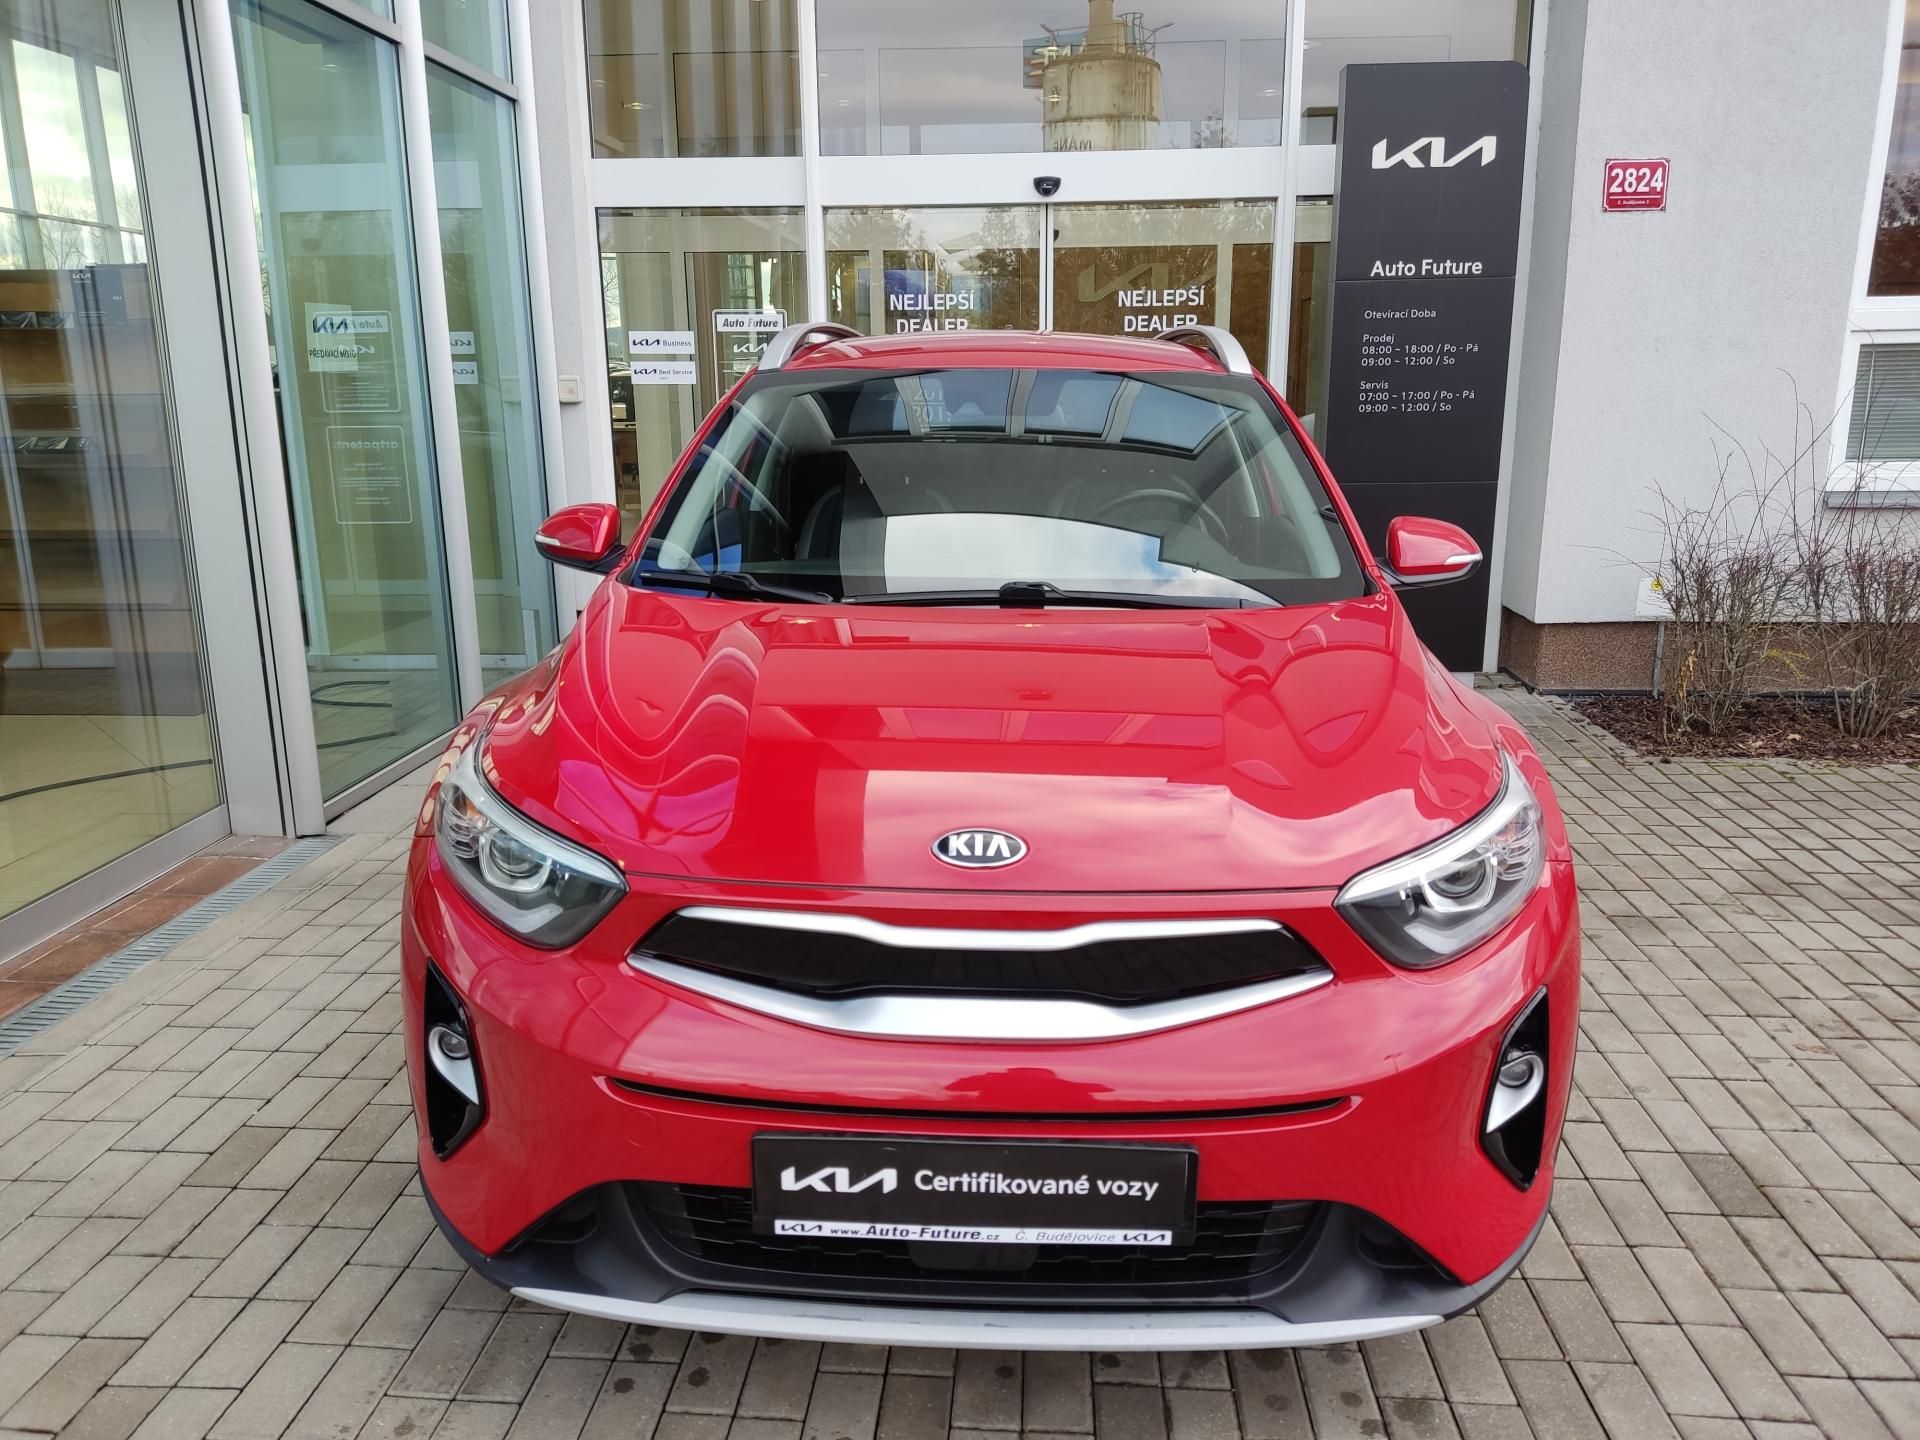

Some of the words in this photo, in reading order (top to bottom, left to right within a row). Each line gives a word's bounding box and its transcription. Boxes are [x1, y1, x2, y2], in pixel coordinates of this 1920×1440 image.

[1372, 135, 1497, 169] KIA
[1609, 167, 1664, 193] 2824
[1370, 260, 1416, 277] Auto
[1421, 259, 1483, 276] Future
[890, 290, 974, 311] NEJLEPŠÍ
[1118, 285, 1205, 307] NEJLEPŠÍ
[1364, 309, 1409, 319] Otevírací
[1411, 309, 1437, 318] Doba
[722, 318, 745, 328] Auto
[747, 318, 779, 328] Future
[632, 338, 660, 347] KIA
[663, 339, 692, 347] Business
[1363, 333, 1395, 344] Prodej
[1362, 345, 1392, 355] 08:00
[1404, 344, 1434, 354] 18:00
[1444, 344, 1457, 353] Po
[1466, 343, 1479, 352] Pá
[1361, 357, 1391, 367] 09:00
[1404, 356, 1433, 366] 12:00
[1442, 355, 1455, 365] So
[1360, 380, 1389, 390] Servis
[1359, 392, 1389, 401] 07:00
[1401, 391, 1430, 400] 17:00
[1440, 390, 1453, 400] Po
[1462, 390, 1475, 399] Pá
[1358, 404, 1389, 413] 09:00
[1401, 403, 1430, 412] 12:00
[1439, 402, 1452, 412] So
[948, 833, 1011, 858] KIA
[781, 1166, 898, 1194] KIA
[914, 1169, 1090, 1195] Certifikované
[1097, 1179, 1159, 1201] vozy
[781, 1223, 823, 1233] KIA
[830, 1224, 1001, 1241] www.Auto-Future.cz
[1015, 1229, 1028, 1241] Č.
[1036, 1231, 1116, 1243] Budějovice
[1122, 1233, 1166, 1243] KIA
